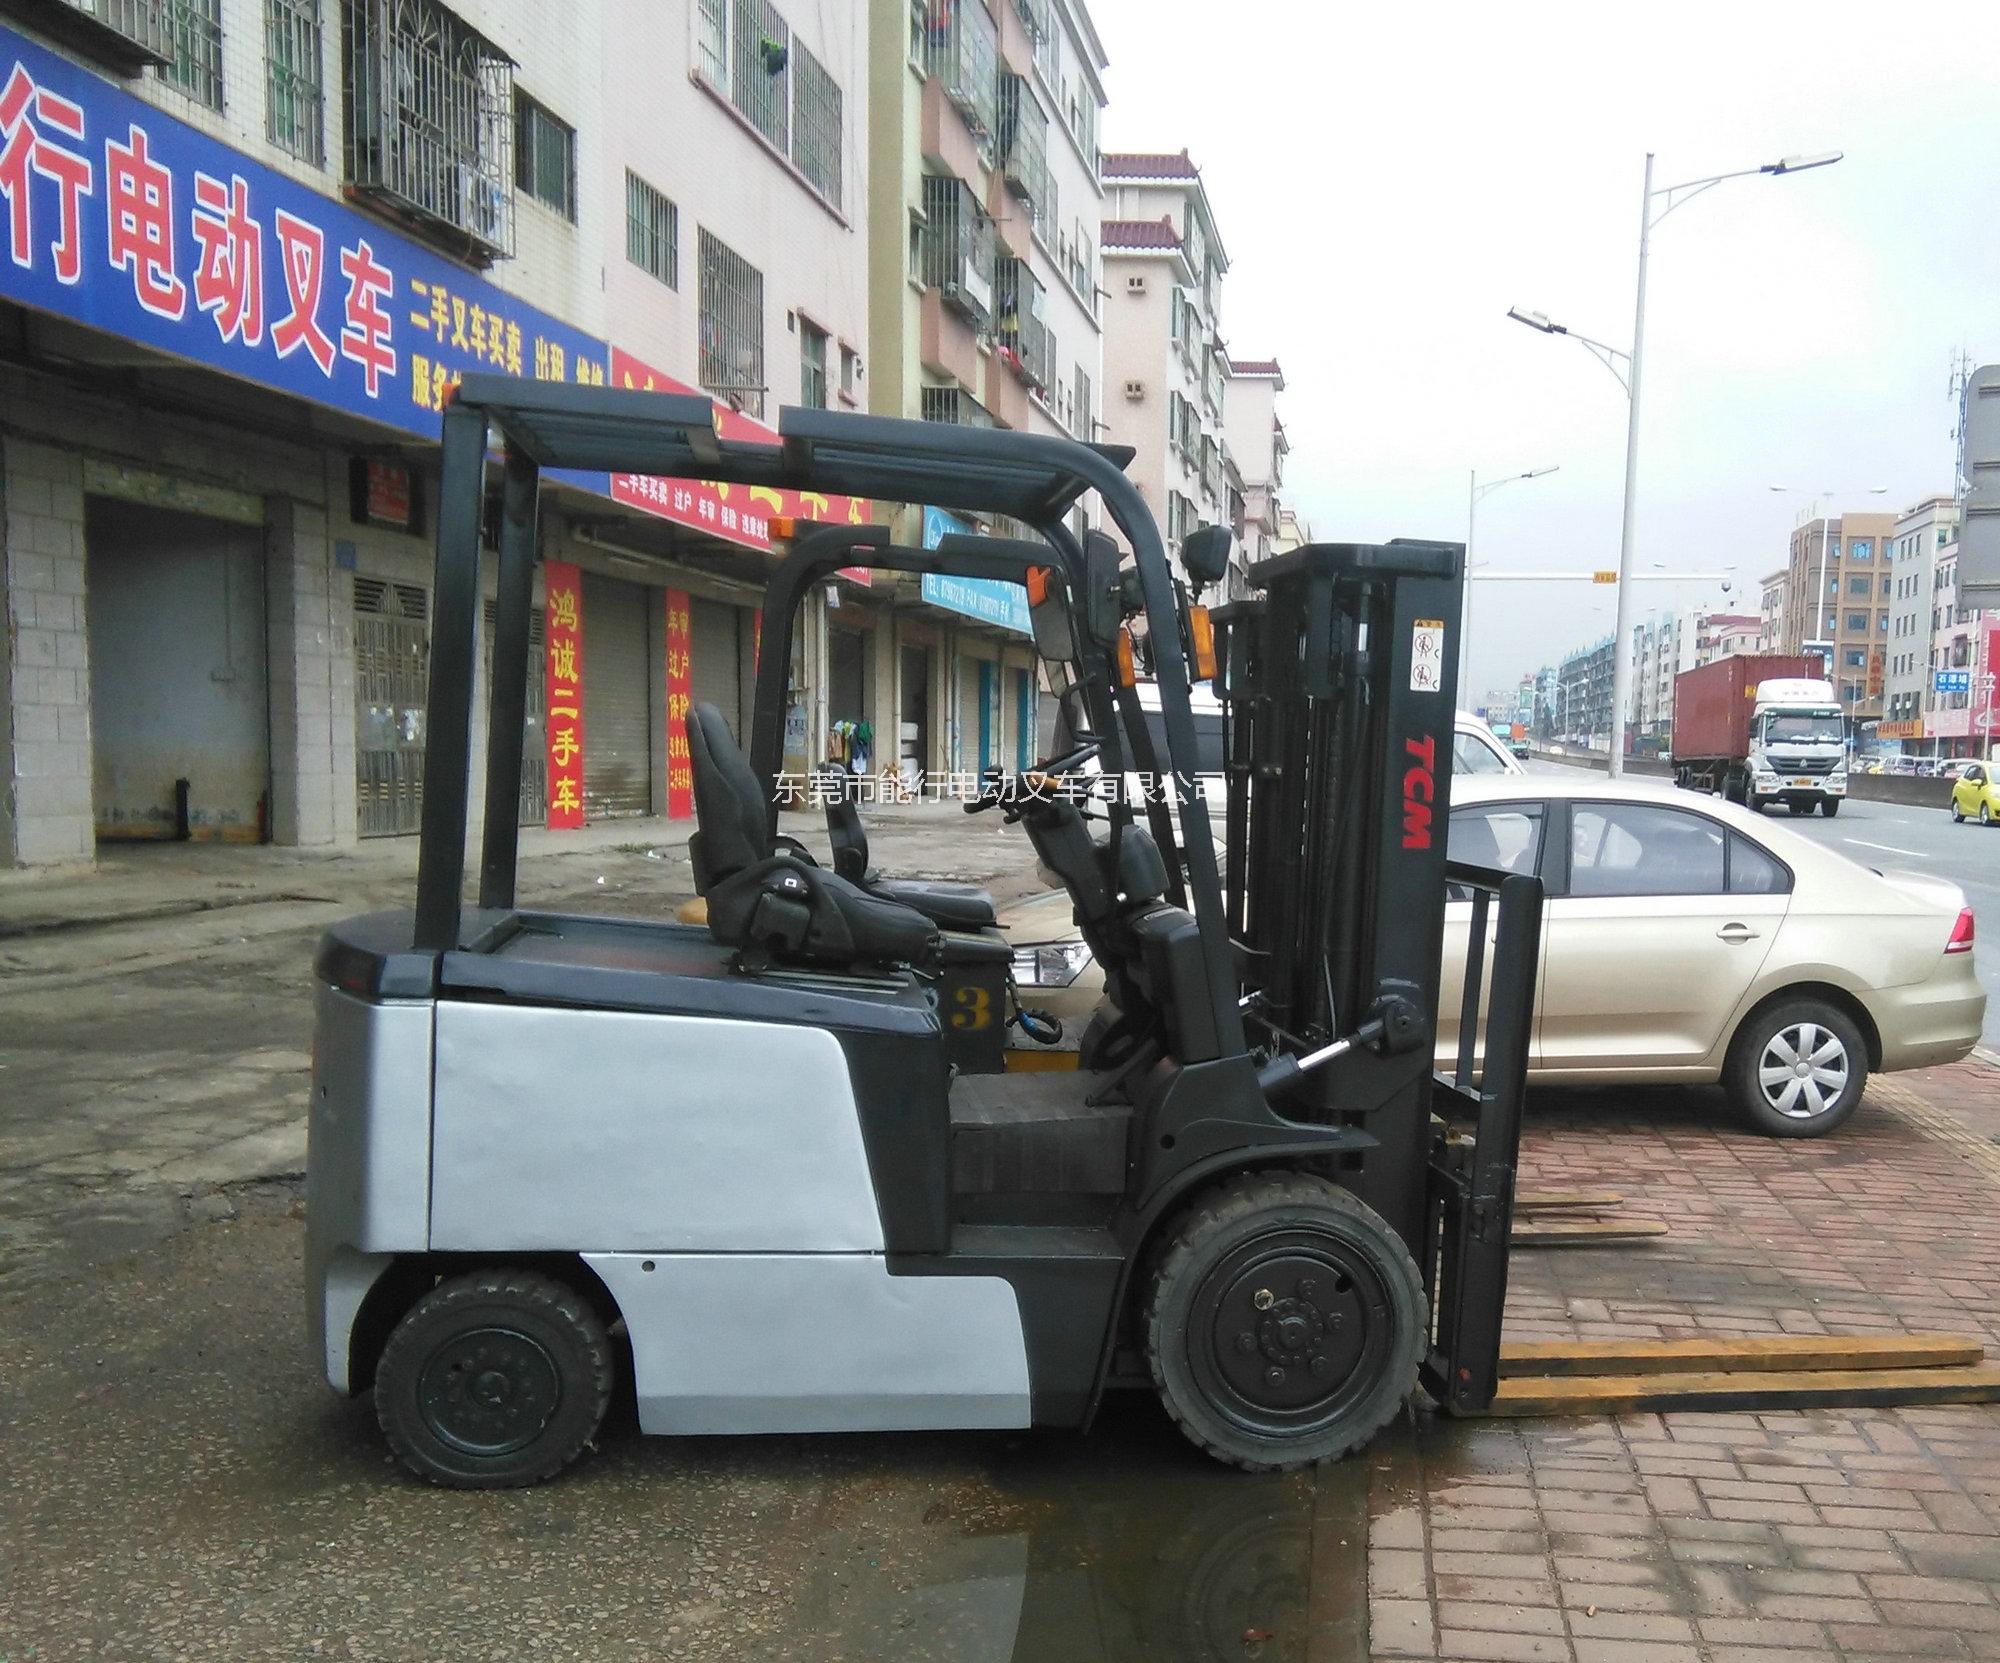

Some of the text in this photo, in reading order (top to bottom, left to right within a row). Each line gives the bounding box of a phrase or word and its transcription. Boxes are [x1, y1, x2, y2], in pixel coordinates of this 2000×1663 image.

[0, 60, 397, 399] 行电动叉车
[410, 278, 523, 377] 二手叉车买卖
[535, 335, 565, 382] 出租
[550, 587, 580, 815] 鸿诚二手车
[1402, 734, 1435, 850] TCM
[951, 986, 990, 1030] 3
